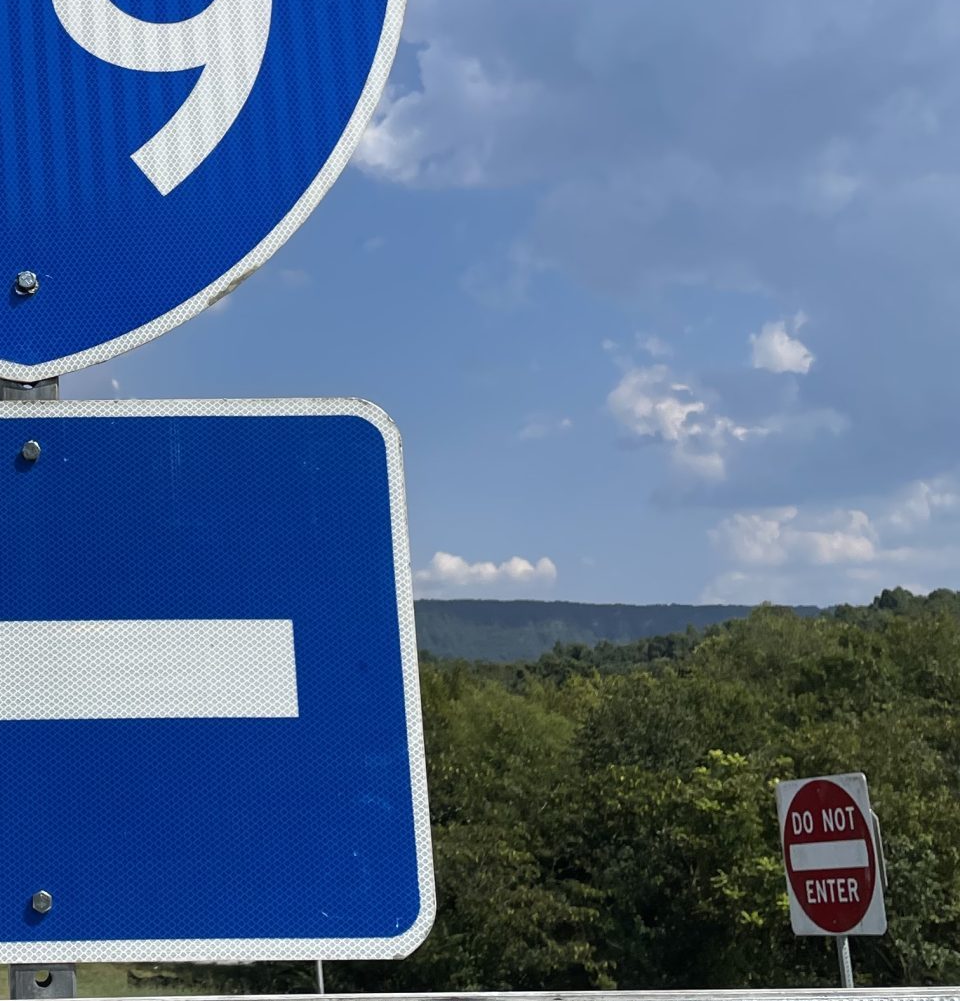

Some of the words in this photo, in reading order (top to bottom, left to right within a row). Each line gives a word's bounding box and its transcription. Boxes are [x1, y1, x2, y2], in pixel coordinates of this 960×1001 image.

[791, 811, 814, 835] DO
[822, 806, 855, 833] NOT
[805, 878, 860, 904] ENTER
